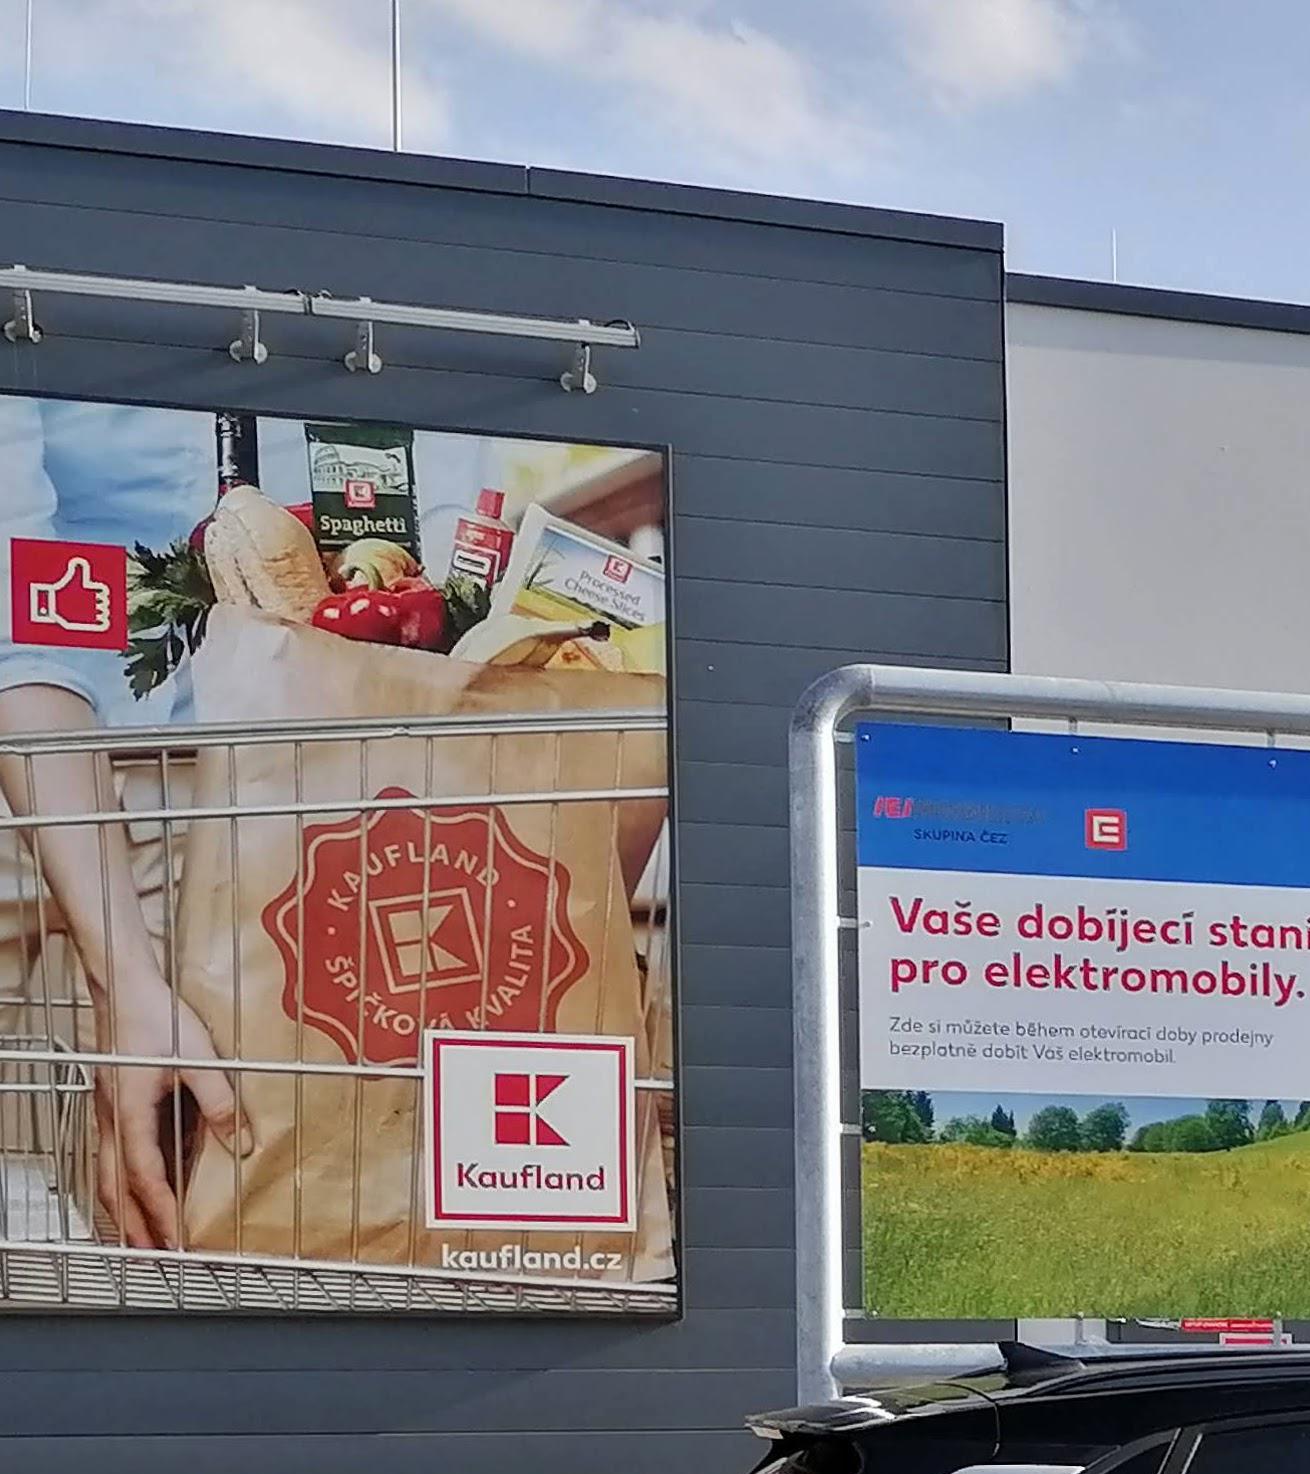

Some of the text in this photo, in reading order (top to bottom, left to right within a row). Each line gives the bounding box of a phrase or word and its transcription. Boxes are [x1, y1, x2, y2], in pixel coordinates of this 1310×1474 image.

[320, 514, 407, 535] Spaghetti
[579, 569, 641, 606] Processed
[913, 828, 1008, 844] SKUPINA ČEZ
[327, 842, 499, 911] KAUFLAND
[889, 896, 1001, 936] Vaše
[1017, 903, 1194, 953] dobíjecí
[465, 924, 533, 1029] KVALITA
[890, 953, 1306, 1006] pro elektromobily.
[889, 1016, 1274, 1048] Zde si můžete během otevírací doby prodejny
[889, 1041, 977, 1061] bezplatně
[457, 1162, 605, 1191] Kaufland
[441, 1243, 624, 1271] kaufland.cz
